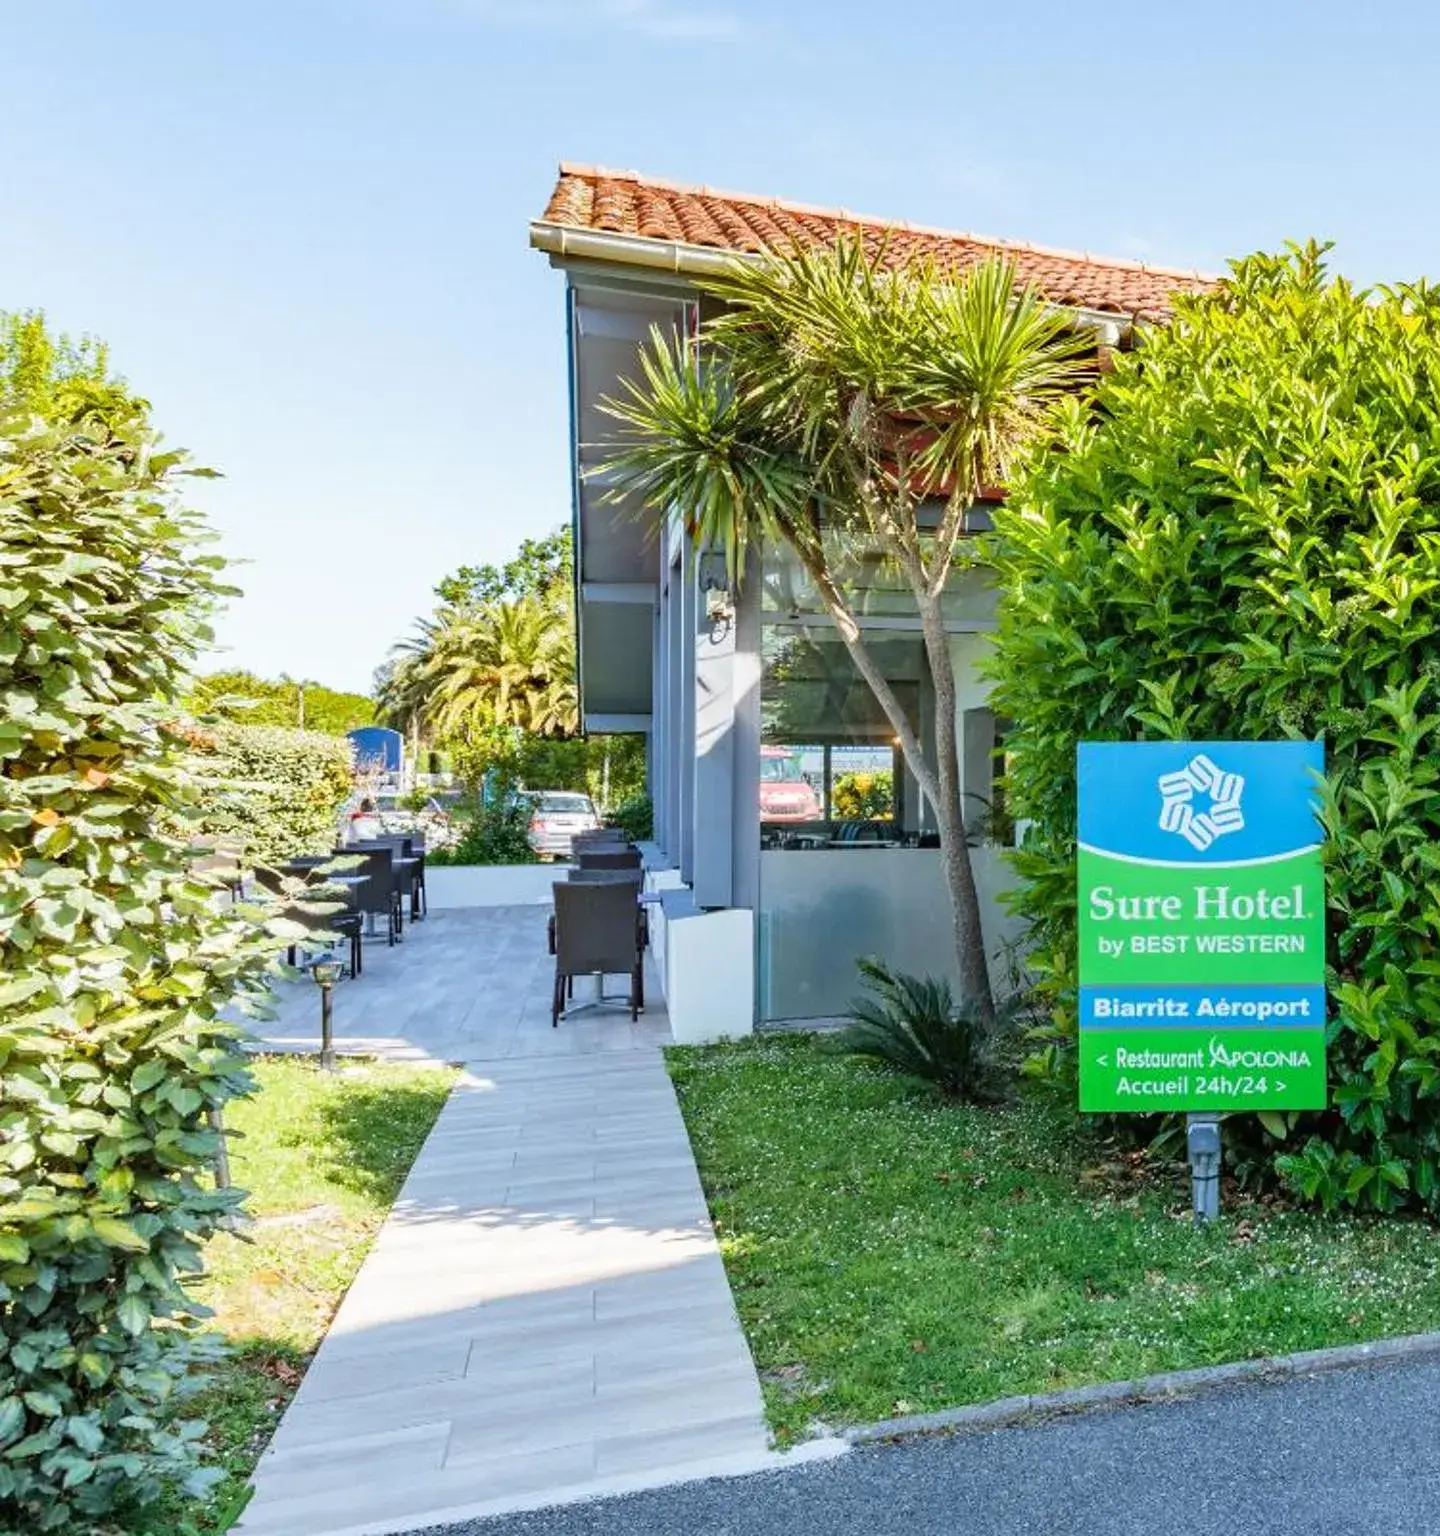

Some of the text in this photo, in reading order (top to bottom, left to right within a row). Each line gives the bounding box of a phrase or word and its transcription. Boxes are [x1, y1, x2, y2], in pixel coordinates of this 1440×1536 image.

[1090, 885, 1182, 920] Sure
[1098, 935, 1305, 958] by BEST WESTERN
[1093, 997, 1311, 1020] Biarritz Aéroport
[1116, 1047, 1204, 1068] Restaurant
[1116, 1076, 1268, 1097] Accueil 24h/24
